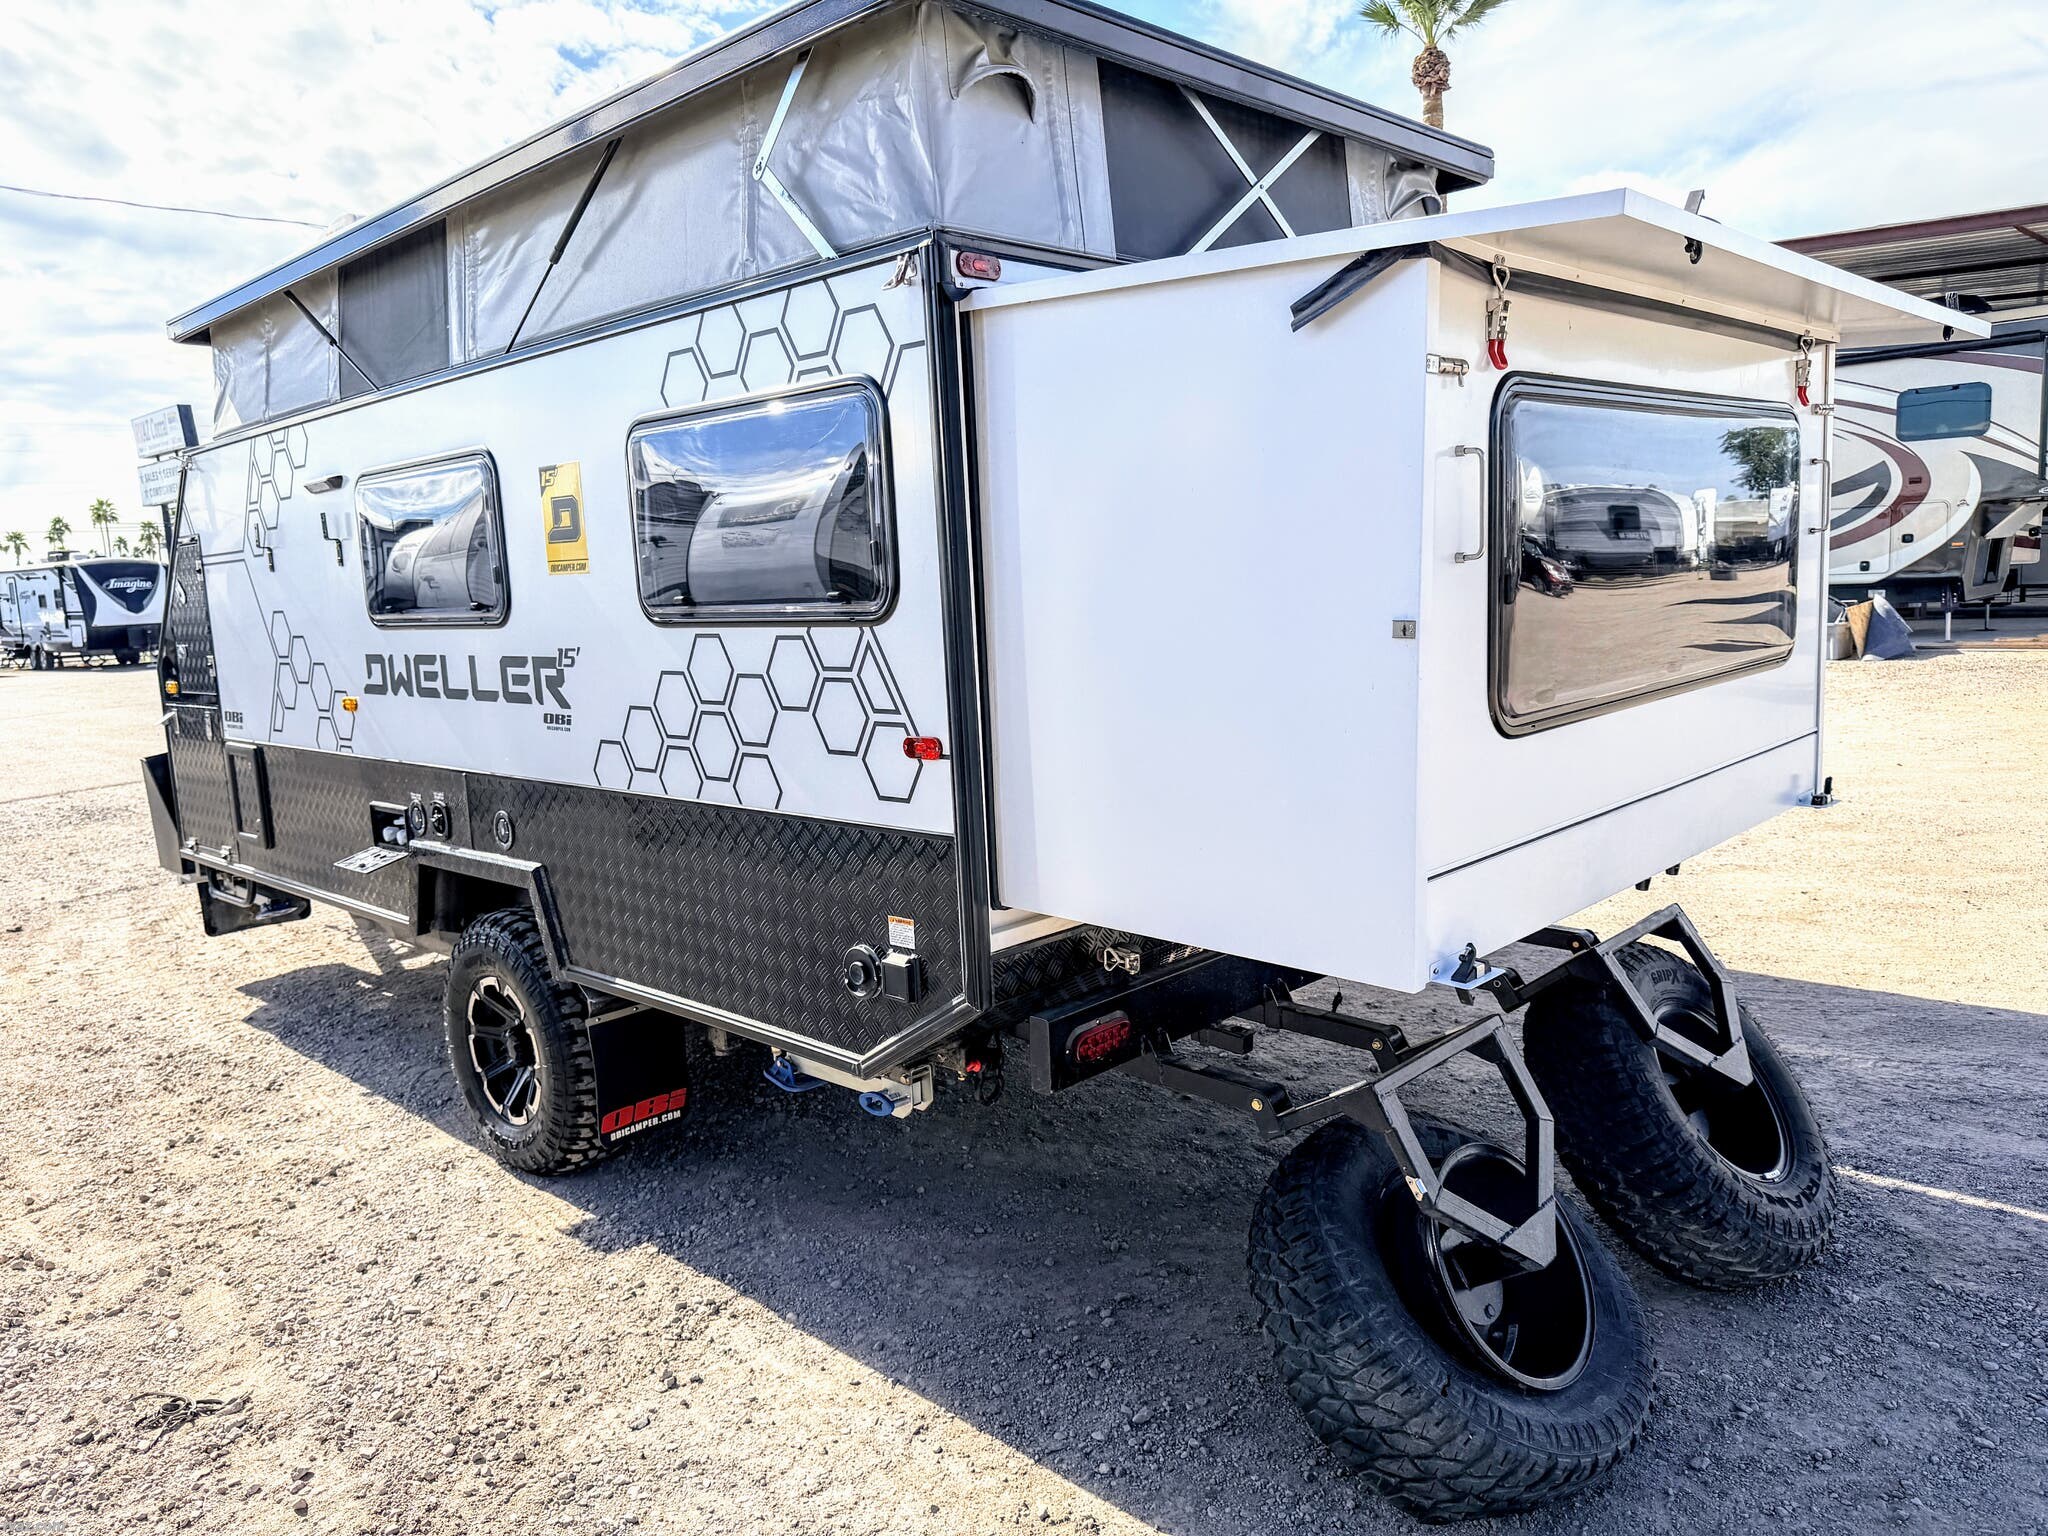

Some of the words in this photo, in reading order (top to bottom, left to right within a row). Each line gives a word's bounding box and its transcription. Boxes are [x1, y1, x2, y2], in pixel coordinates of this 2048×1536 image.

[548, 495, 581, 544] D
[104, 577, 153, 593] Imagine
[364, 653, 571, 709] DWELLER
[610, 1109, 681, 1142] OBICAMPER.COM
